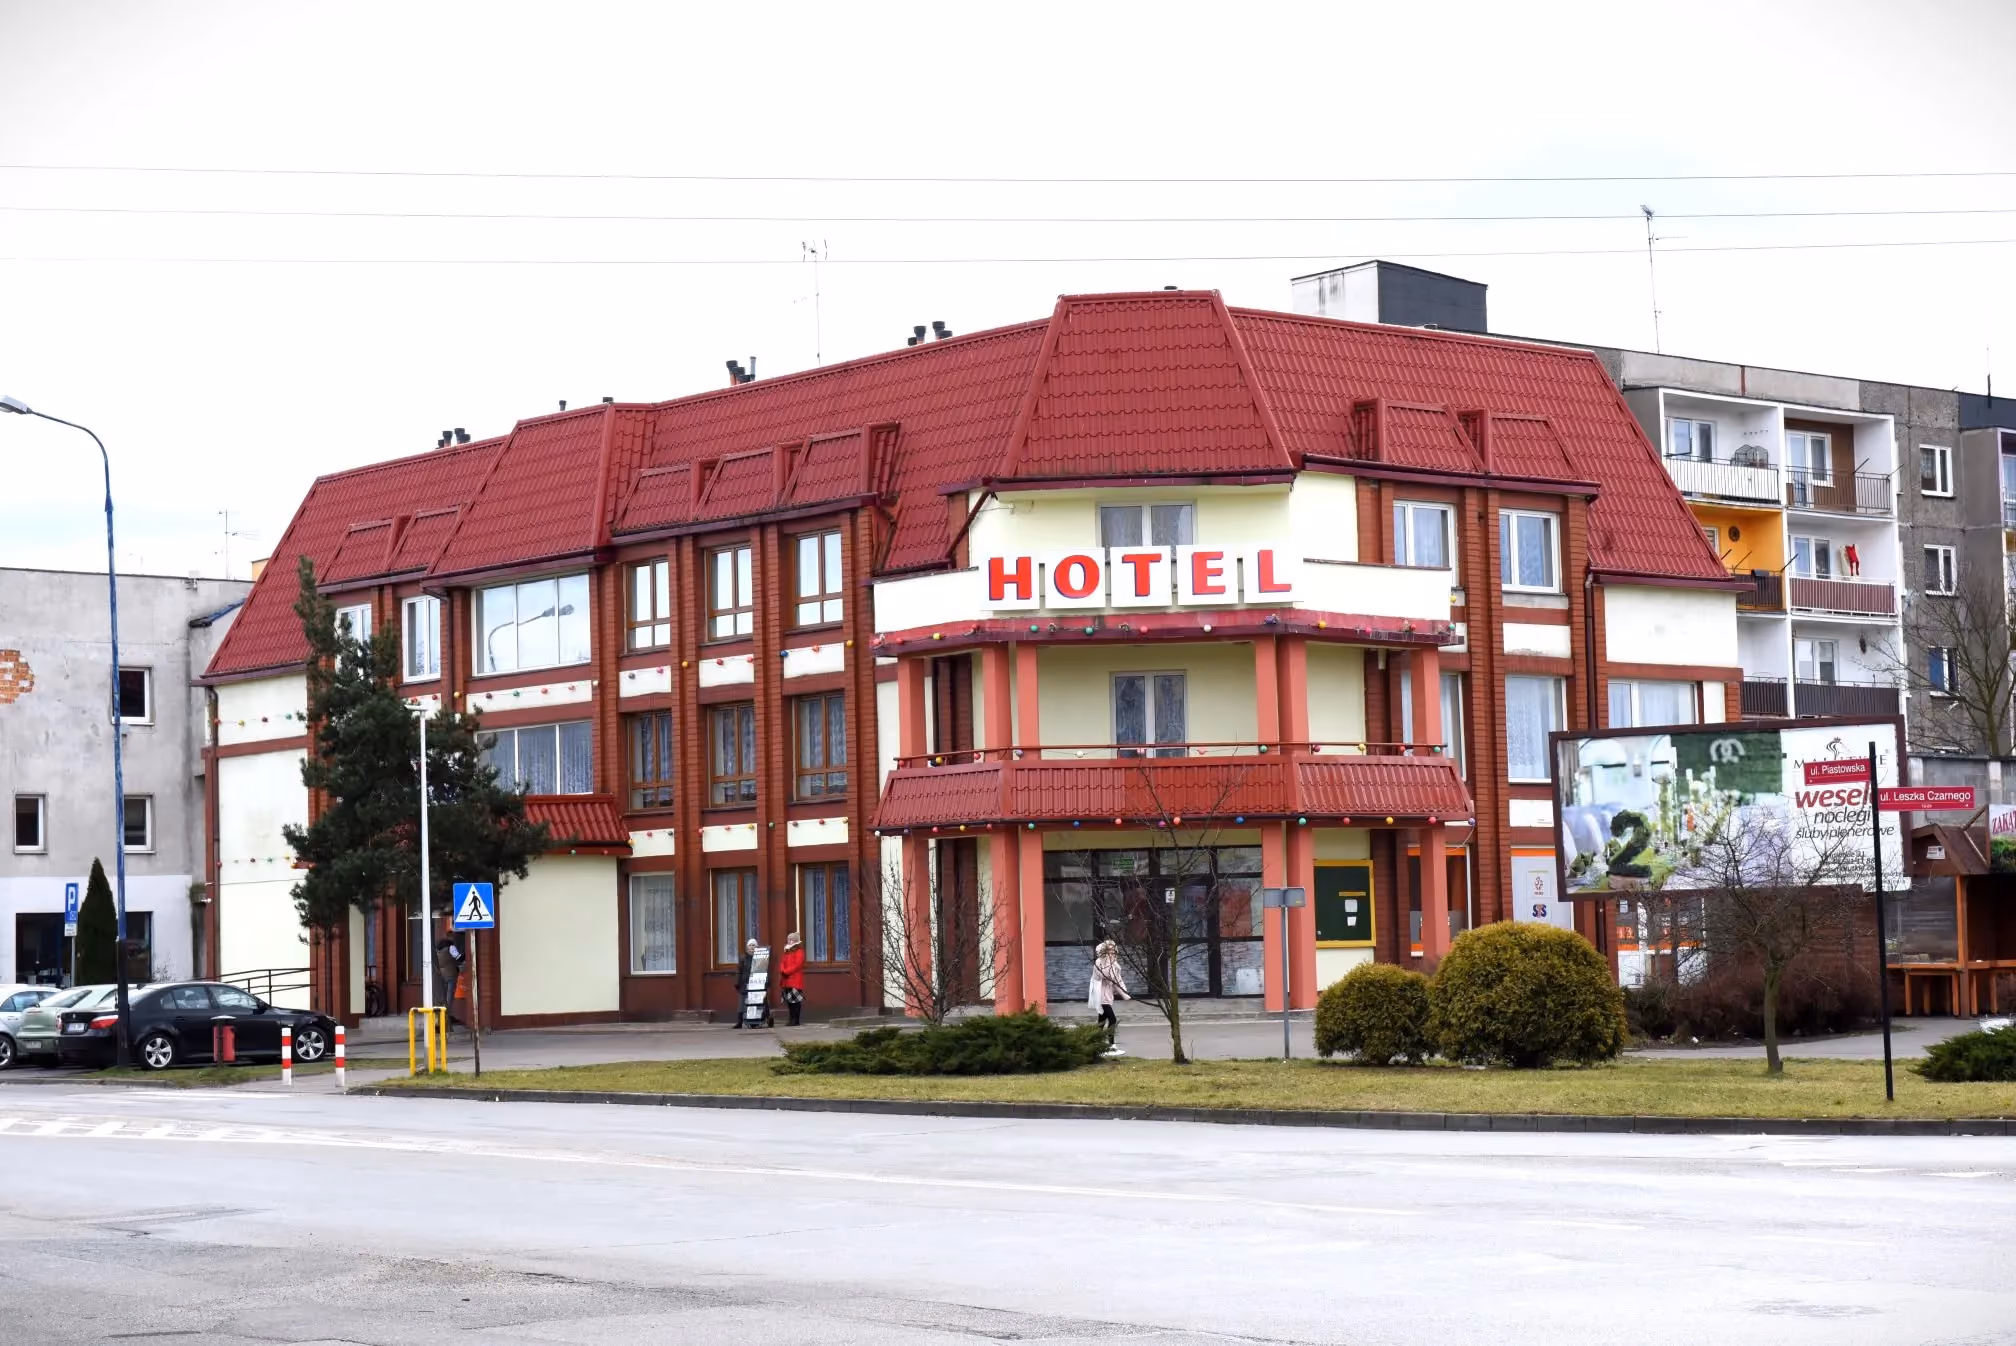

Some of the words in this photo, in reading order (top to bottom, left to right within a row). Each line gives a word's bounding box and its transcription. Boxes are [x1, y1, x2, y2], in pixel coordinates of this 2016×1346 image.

[988, 549, 1292, 601] HOTEL
[1810, 766, 1820, 775] ul.
[1822, 763, 1866, 774] Piastowska
[1795, 782, 1873, 808] wesel
[1880, 793, 1890, 801] ul.
[1893, 792, 1925, 801] Leszka
[1927, 791, 1971, 802] Czarnego
[1814, 806, 1872, 826] noclegi
[68, 886, 76, 911] P
